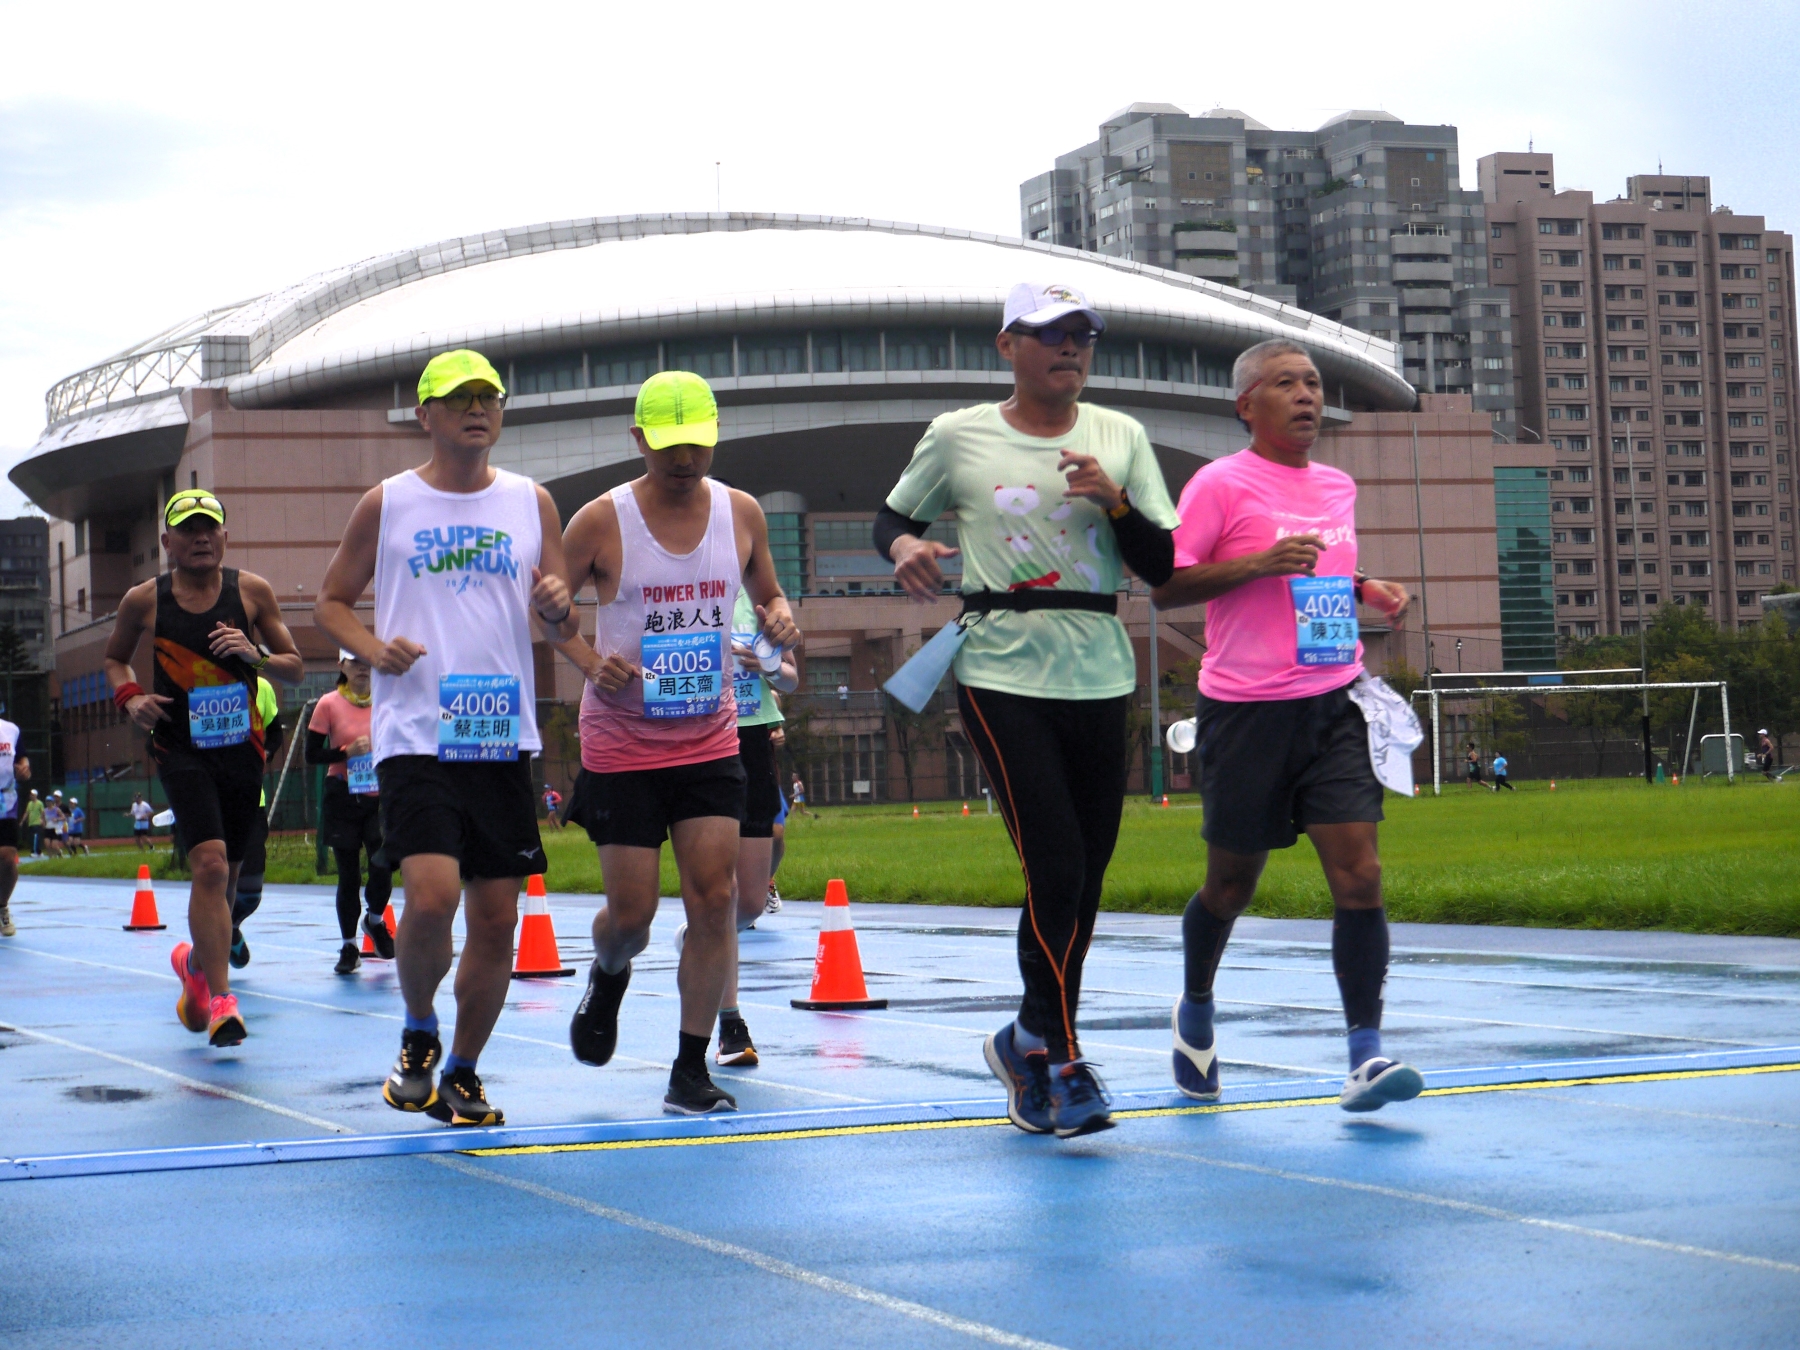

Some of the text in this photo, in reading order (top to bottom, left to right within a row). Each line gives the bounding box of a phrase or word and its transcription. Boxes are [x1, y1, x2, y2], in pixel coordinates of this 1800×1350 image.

[413, 525, 513, 556] SUPER
[407, 547, 519, 581] FUNRUN
[643, 579, 726, 605] POWER RUN
[1304, 594, 1351, 618] 4029
[644, 605, 724, 633] 跑浪人生
[652, 649, 712, 674] 4005
[196, 696, 242, 716] 4002
[449, 692, 510, 716] 4006
[454, 719, 511, 739] 蔡志明
